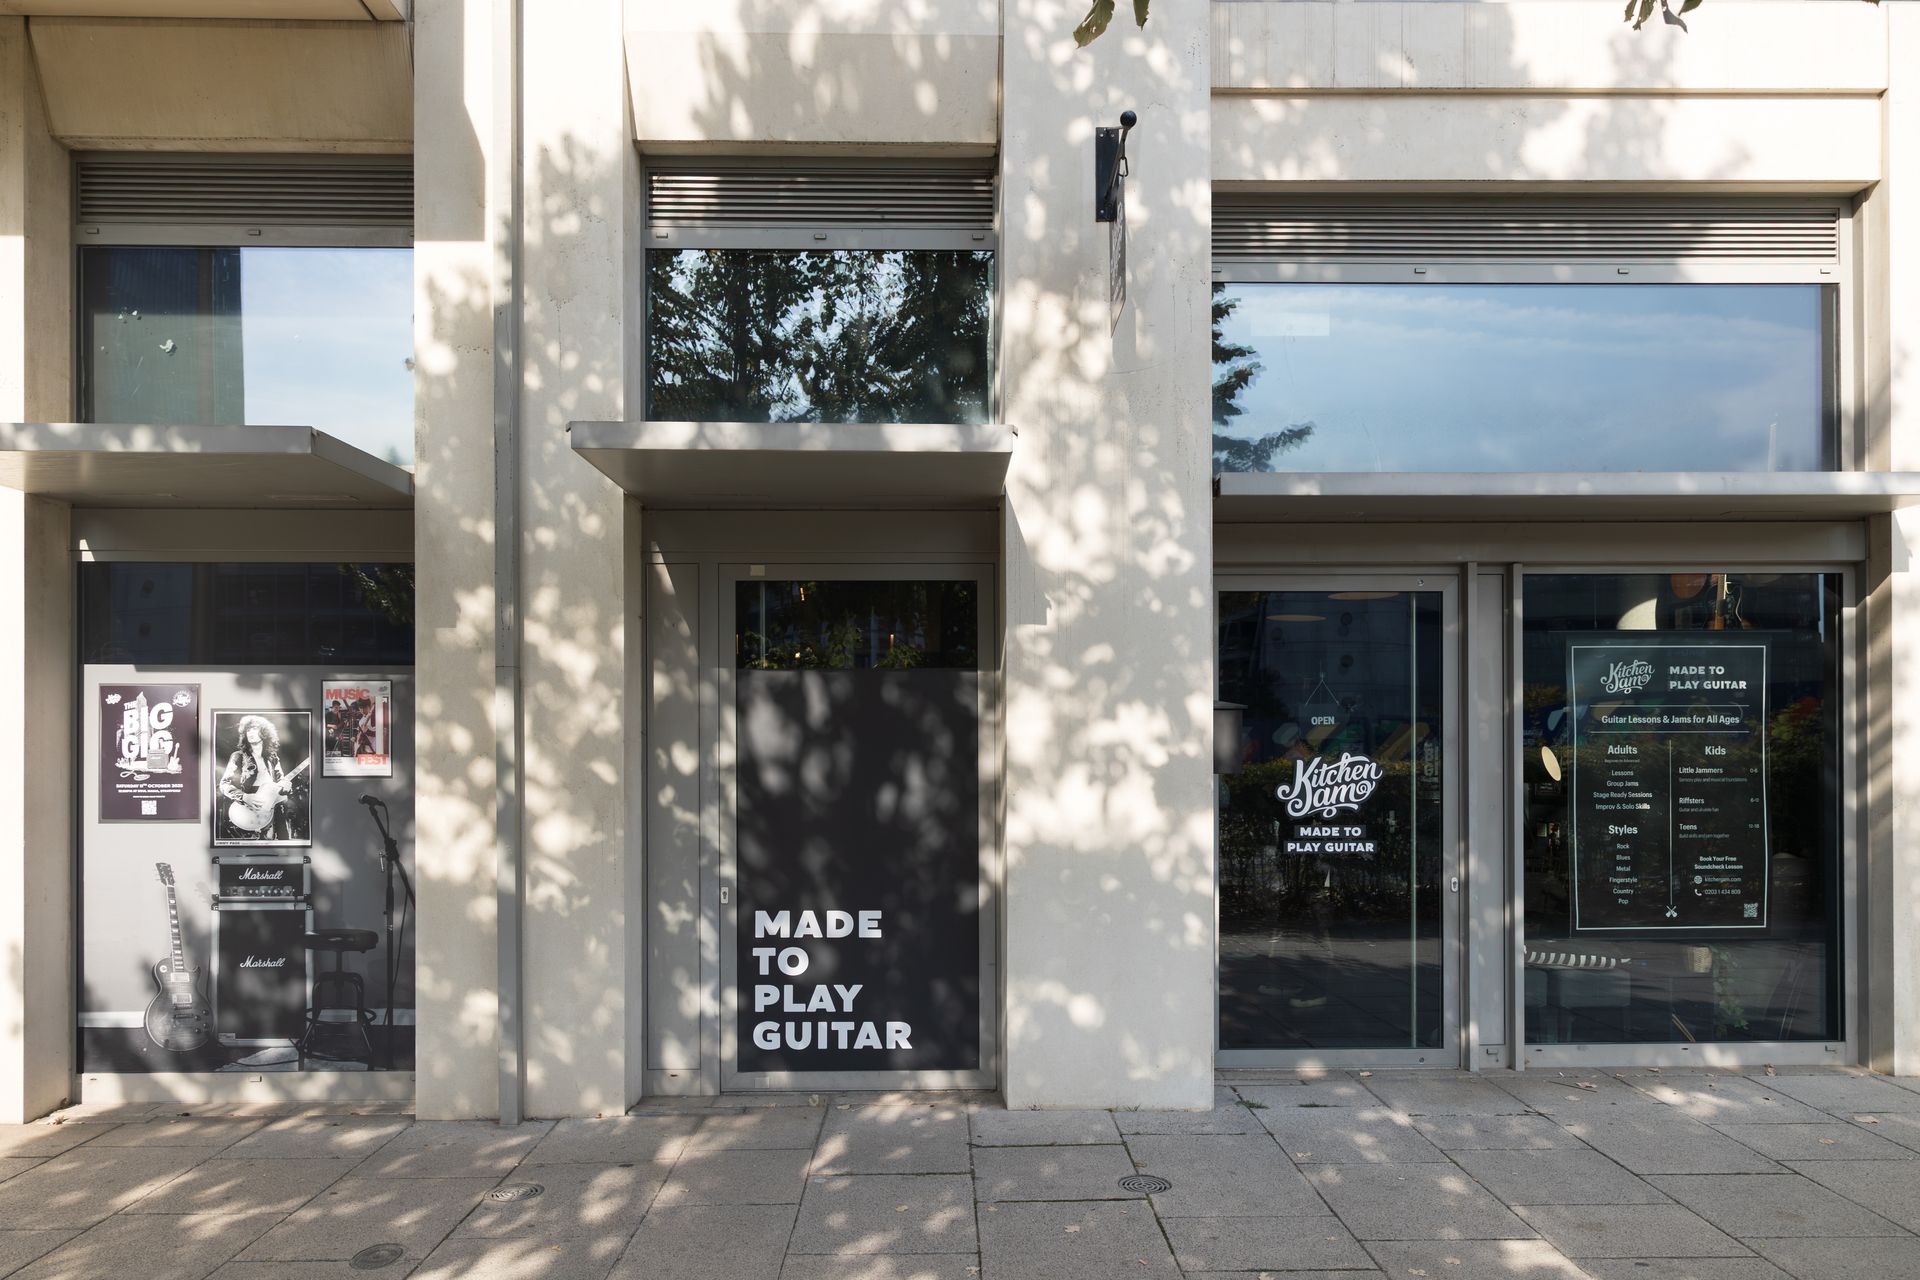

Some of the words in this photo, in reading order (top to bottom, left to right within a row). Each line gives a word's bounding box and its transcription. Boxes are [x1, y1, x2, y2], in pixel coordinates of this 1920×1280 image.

[1600, 660, 1655, 684] Kitchen
[1670, 666, 1705, 675] MADE
[1709, 666, 1724, 675] TO
[1670, 680, 1699, 689] PLAY
[1703, 680, 1747, 689] GUITAR
[325, 688, 369, 701] MUSIC
[123, 702, 173, 734] BIG
[1311, 716, 1335, 725] OPEN
[1602, 715, 1627, 724] Guitar
[1628, 715, 1661, 724] Lessons
[1663, 715, 1669, 724] &
[1671, 715, 1691, 724] Jams
[1693, 715, 1706, 724] for
[1707, 715, 1717, 724] All
[1719, 715, 1740, 726] Ages
[121, 730, 173, 759] GIG
[1607, 744, 1638, 755] Adults
[1705, 745, 1727, 755] Kids
[357, 754, 389, 766] FEST
[1277, 752, 1383, 800] Kitchen
[1287, 780, 1376, 818] Jam
[1596, 803, 1615, 811] Improv
[1300, 827, 1340, 836] MADE
[1343, 827, 1362, 836] TO
[1608, 825, 1638, 836] Styles
[1287, 842, 1320, 852] PLAY
[1325, 842, 1374, 852] GUITAR
[239, 867, 284, 880] Marshall
[755, 910, 883, 939] MADE
[239, 955, 286, 968] Marshall
[752, 946, 810, 977] TO
[755, 984, 864, 1013] PLAY
[752, 1020, 913, 1051] GUITAR
